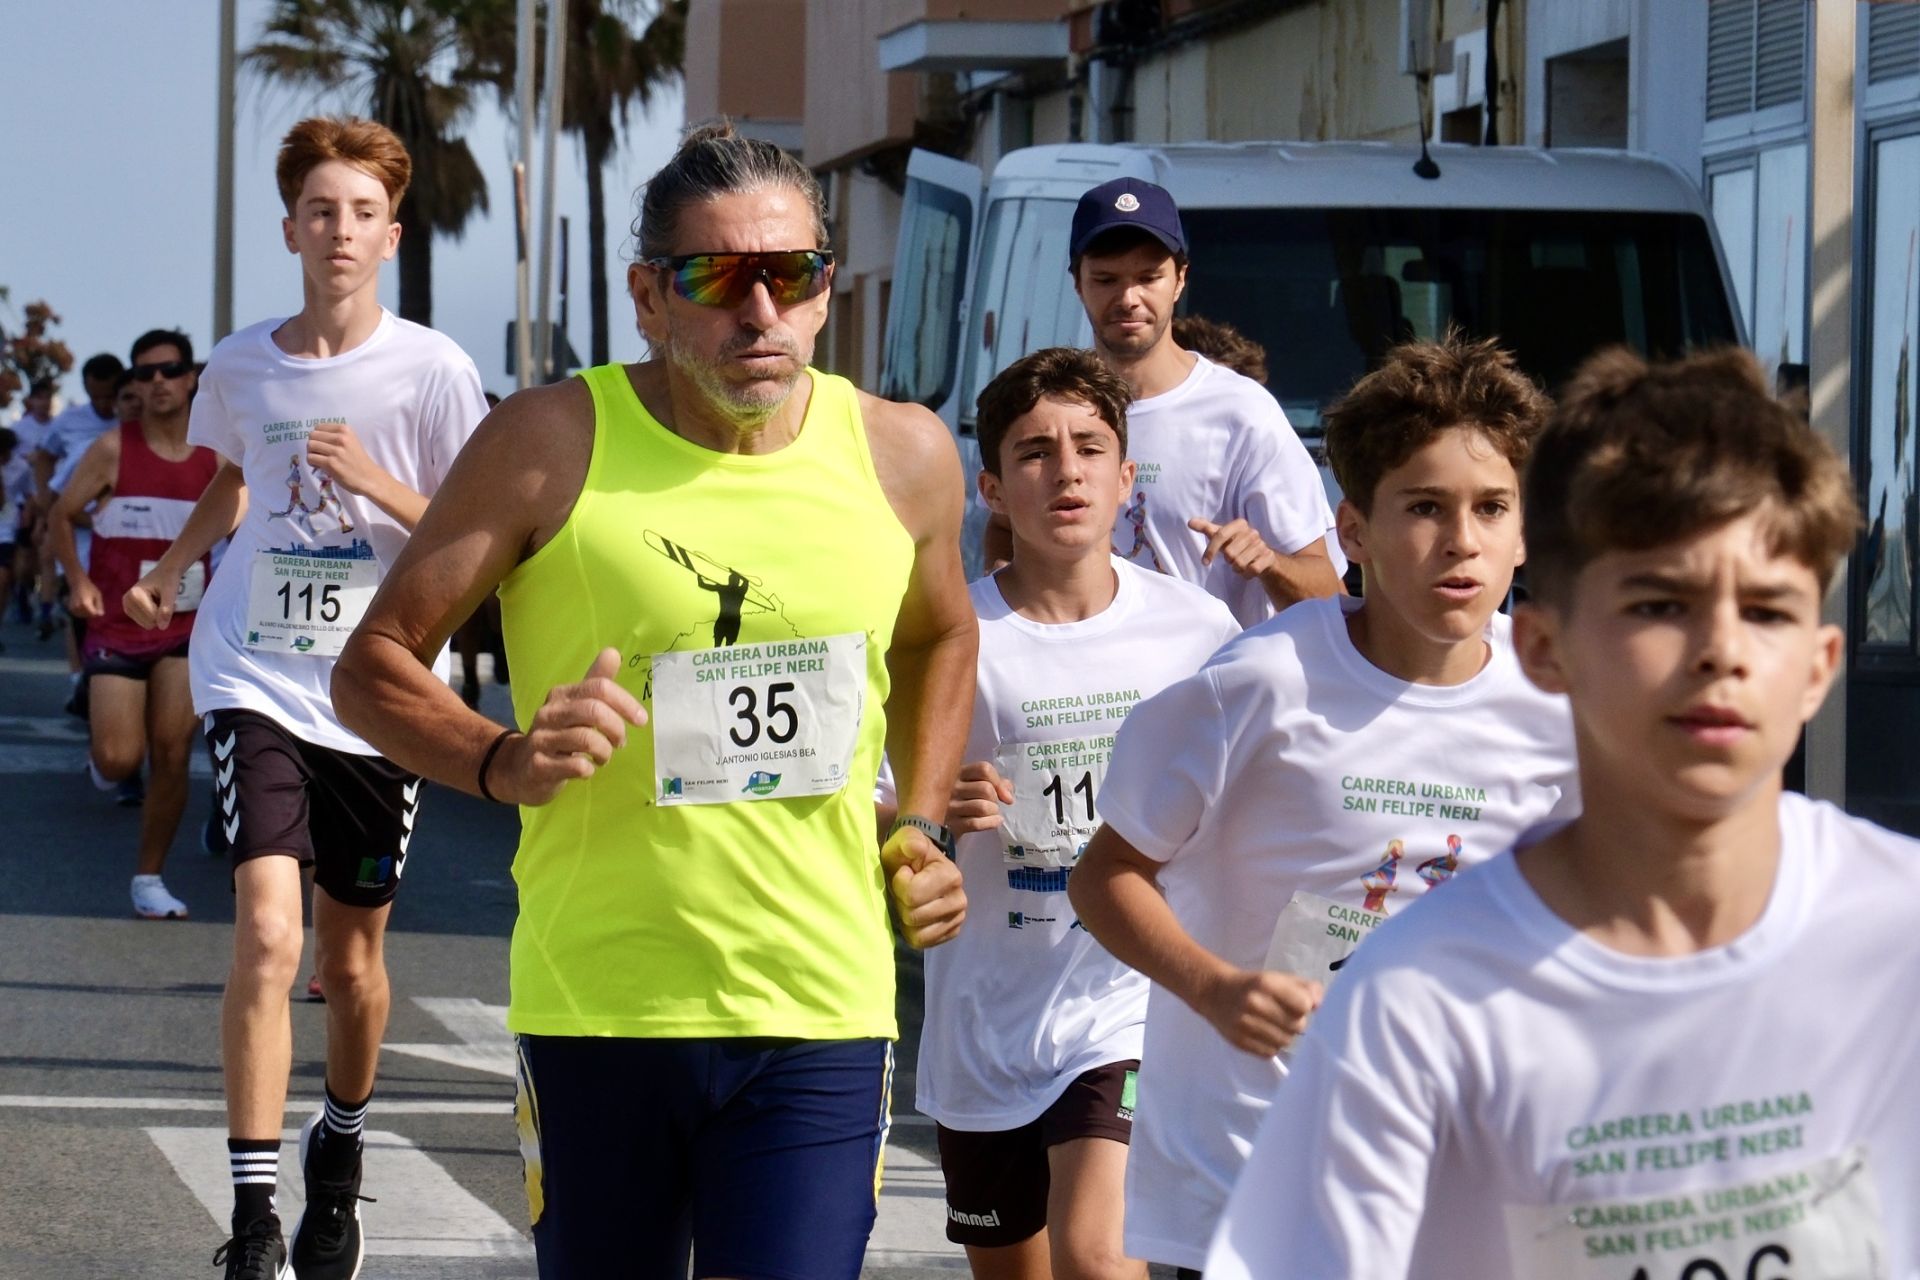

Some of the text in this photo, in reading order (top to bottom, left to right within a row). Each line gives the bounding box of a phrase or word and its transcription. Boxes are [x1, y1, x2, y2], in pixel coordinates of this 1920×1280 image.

[263, 420, 303, 433] CARRERA
[265, 430, 310, 444] SAN FELIP
[273, 556, 353, 569] CARRERA URBANA
[274, 567, 350, 581] SAN FELIPE NERI
[277, 580, 342, 623] 115
[692, 641, 829, 666] CARRERA URBANA
[695, 658, 825, 683] SAN FELIPE NERI
[1021, 689, 1142, 713] CARRERA URBANA
[729, 682, 799, 748] 35
[1026, 705, 1131, 729] SAN FELIPE NER
[760, 749, 798, 761] IGLESIAS
[799, 748, 816, 758] BEA
[1027, 736, 1114, 757] CARRERA URB
[1031, 757, 1057, 771] SAN
[1061, 752, 1103, 768] FELIPE
[1043, 770, 1095, 824] 11
[1341, 775, 1487, 802] CARRERA URBANA
[1342, 796, 1482, 821] SAN FELIPE NERI
[1328, 904, 1383, 929] CARRE
[1325, 922, 1360, 943] SAN
[1566, 1092, 1813, 1150] CARRERA URBANA
[1572, 1125, 1805, 1177] SAN FELIPE NERI
[1573, 1173, 1810, 1229] CARRERA URBANA
[1585, 1203, 1805, 1258] SAN FELIPE NERI
